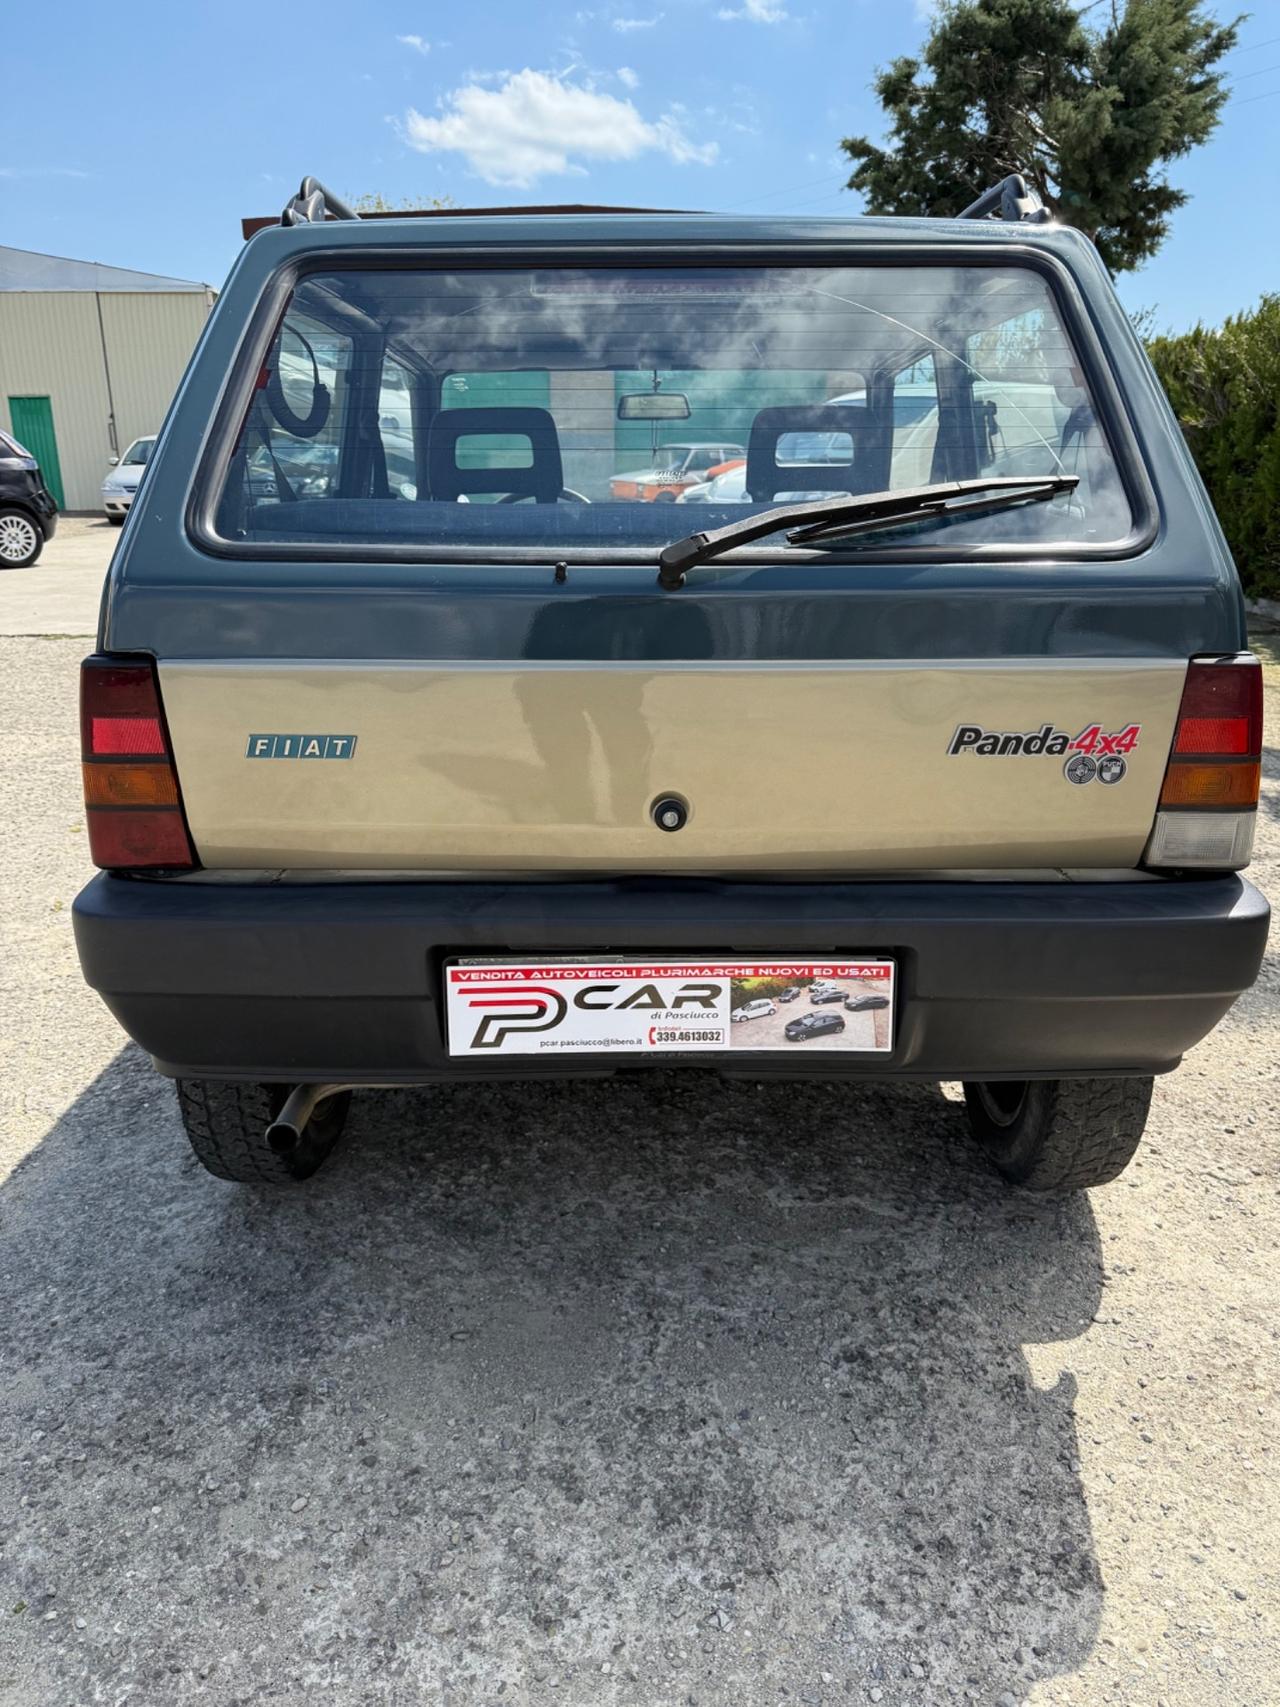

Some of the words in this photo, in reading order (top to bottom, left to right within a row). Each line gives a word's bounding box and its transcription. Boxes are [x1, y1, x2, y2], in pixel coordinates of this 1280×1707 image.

[950, 726, 1070, 755] Panda
[1068, 726, 1141, 755] 4x4
[255, 739, 348, 756] FIAT
[457, 971, 526, 980] VENDITA
[530, 970, 637, 979] AUTOVEICOLI
[640, 969, 755, 977] PLURIMARCHE
[758, 968, 808, 976] NUOVI
[813, 968, 833, 976] ED
[837, 968, 885, 976] USATI
[651, 1011, 662, 1019] di
[665, 1010, 719, 1020] Pasciucco
[657, 1031, 721, 1042] 339.4613032
[540, 1038, 643, 1048] pcar.pasciucco@libero.it
